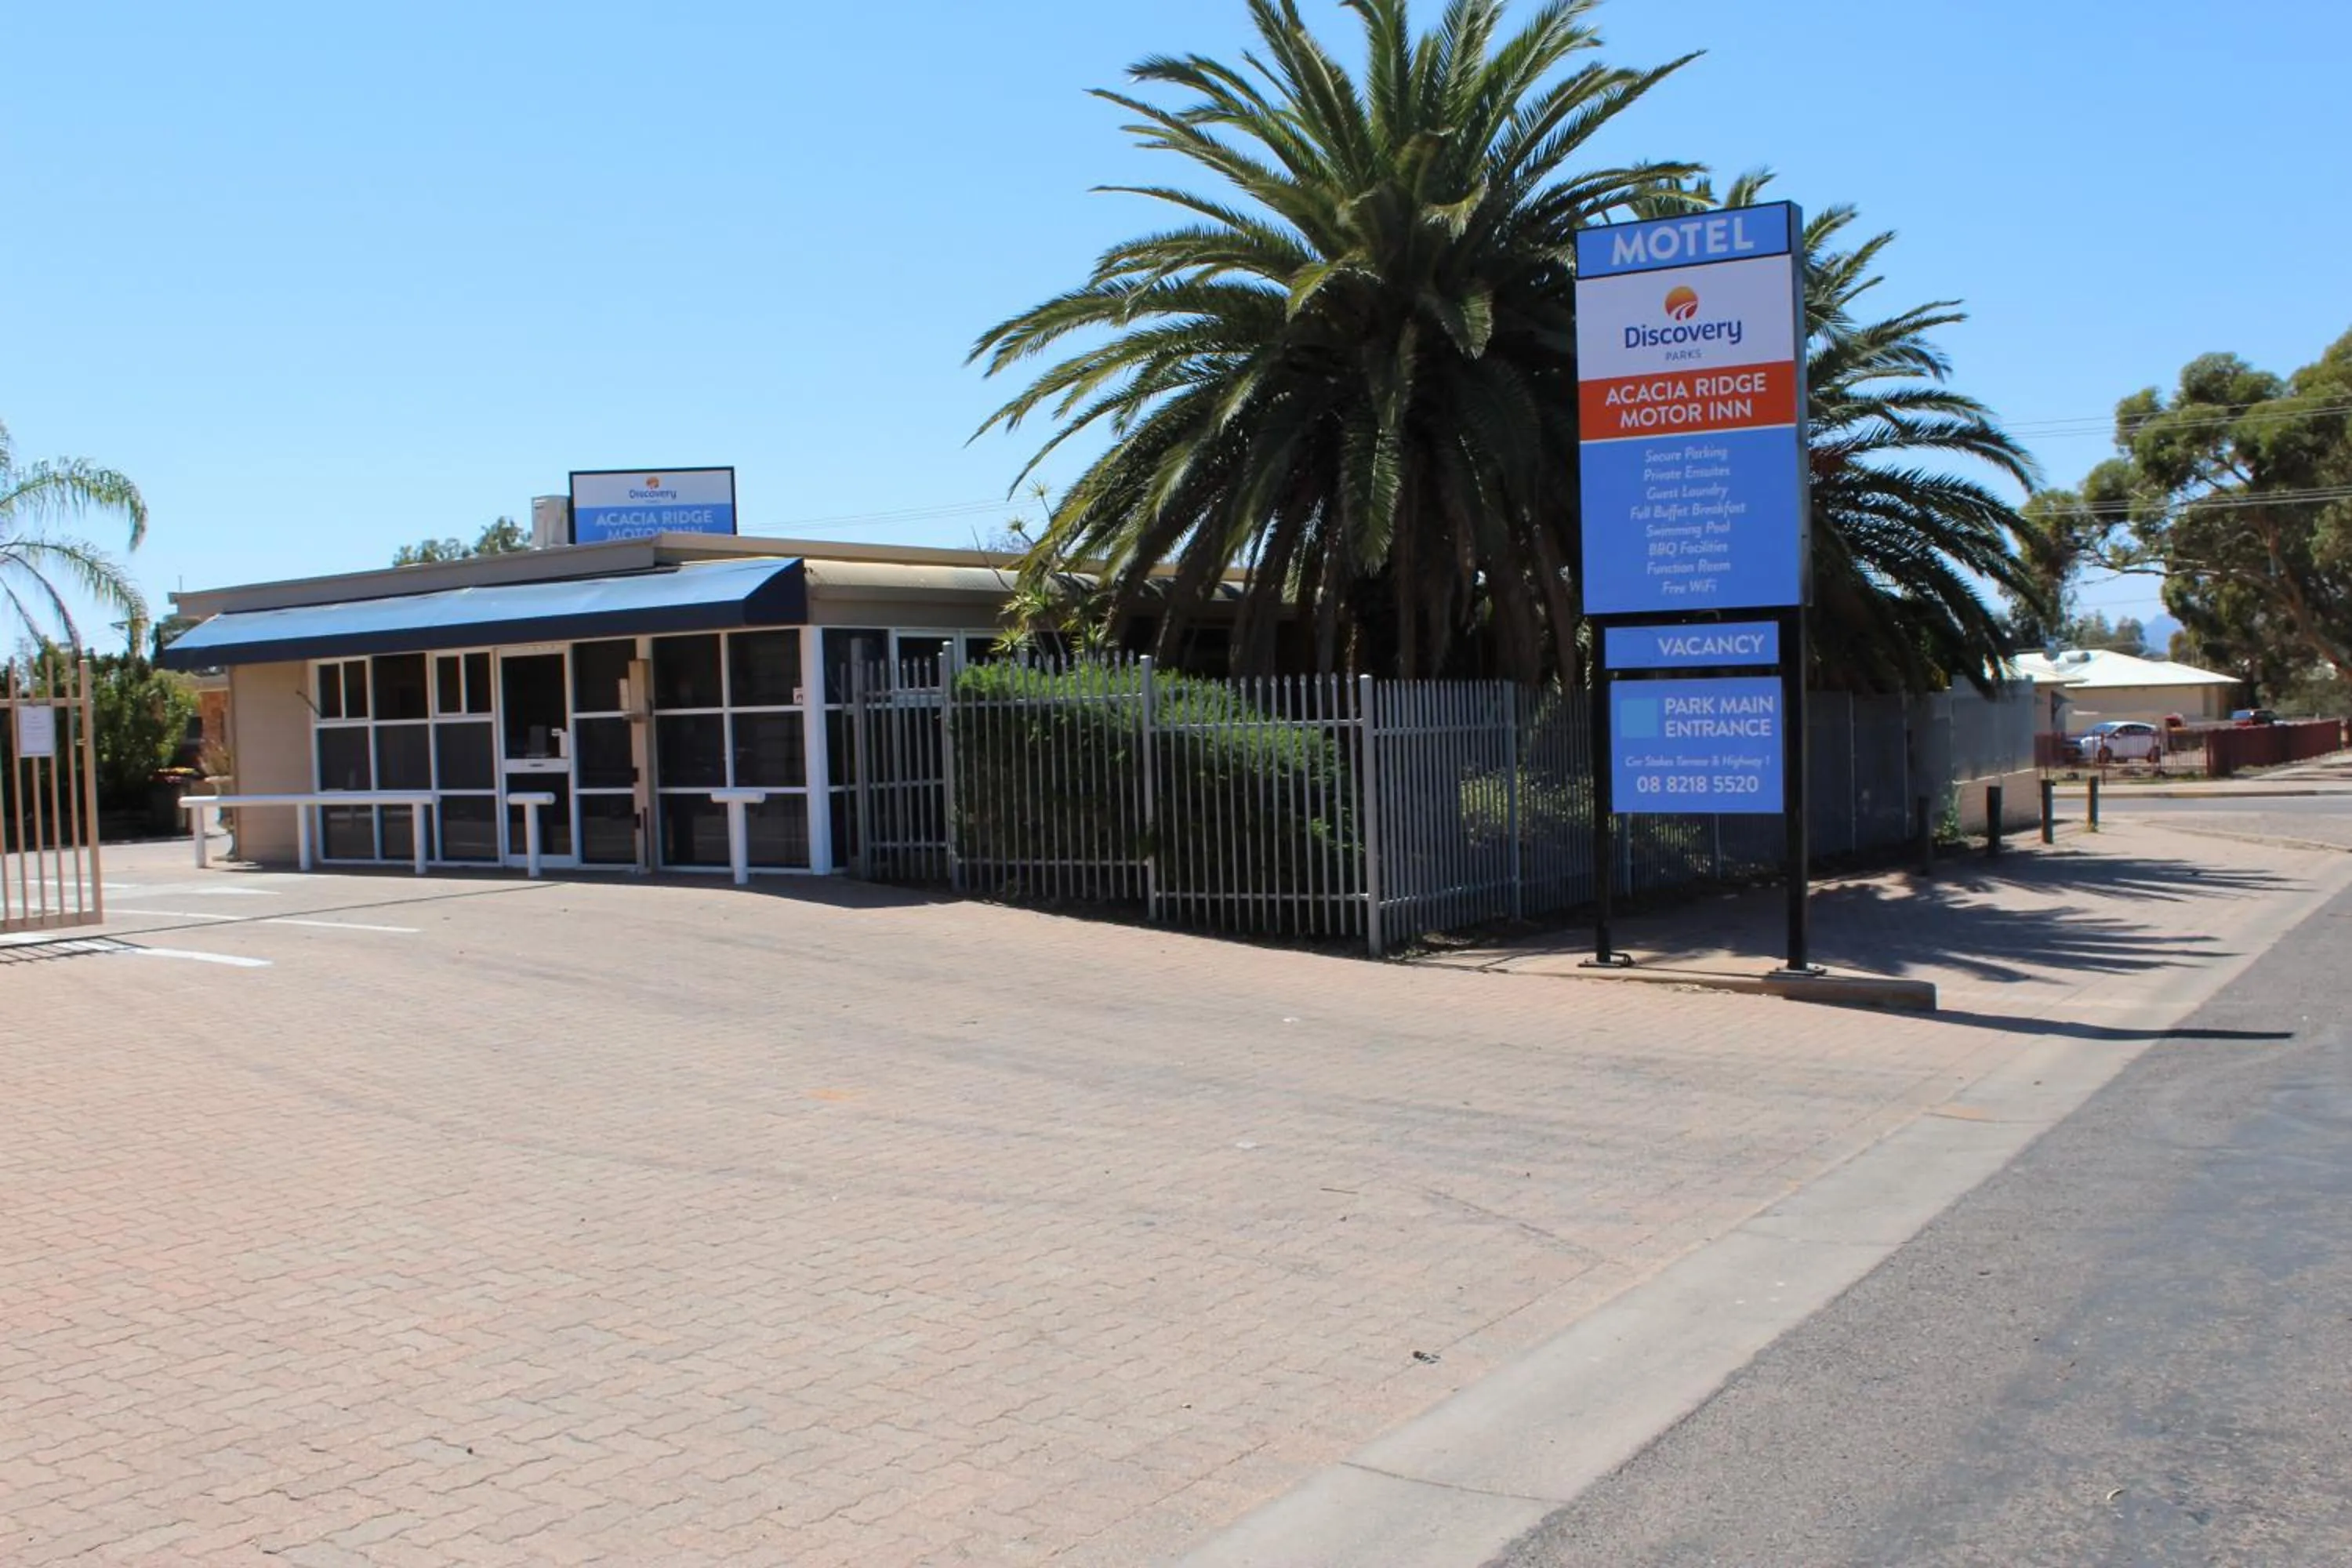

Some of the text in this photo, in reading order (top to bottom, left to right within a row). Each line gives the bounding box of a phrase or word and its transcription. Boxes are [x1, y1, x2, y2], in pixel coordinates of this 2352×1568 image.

[1611, 217, 1755, 266] MOTEL
[1624, 319, 1743, 349] Discovery
[1665, 349, 1701, 361] PARKS
[1605, 372, 1767, 407] ACACIA RIDGE
[1620, 398, 1752, 429] MOTOR INN
[1644, 444, 1728, 463] Secure Parking
[1643, 465, 1731, 481] Private Ensuites
[629, 488, 677, 500] Discovery
[1646, 482, 1729, 500] Guest Laundry
[596, 510, 713, 527] ACACIA RIDGE
[1630, 502, 1747, 521] Full Buffet Breakfast
[1646, 521, 1730, 539] Swimming Pool
[1649, 539, 1728, 557] BBQ Facilities
[1647, 558, 1731, 575] Function Room
[1661, 580, 1686, 595] Free
[1657, 633, 1765, 656] VACANCY
[1664, 695, 1774, 716] PARK MAIN
[1665, 718, 1773, 738] ENTRANCE
[1722, 753, 1762, 770] Highway
[1636, 775, 1759, 793] 08 8218 5520
